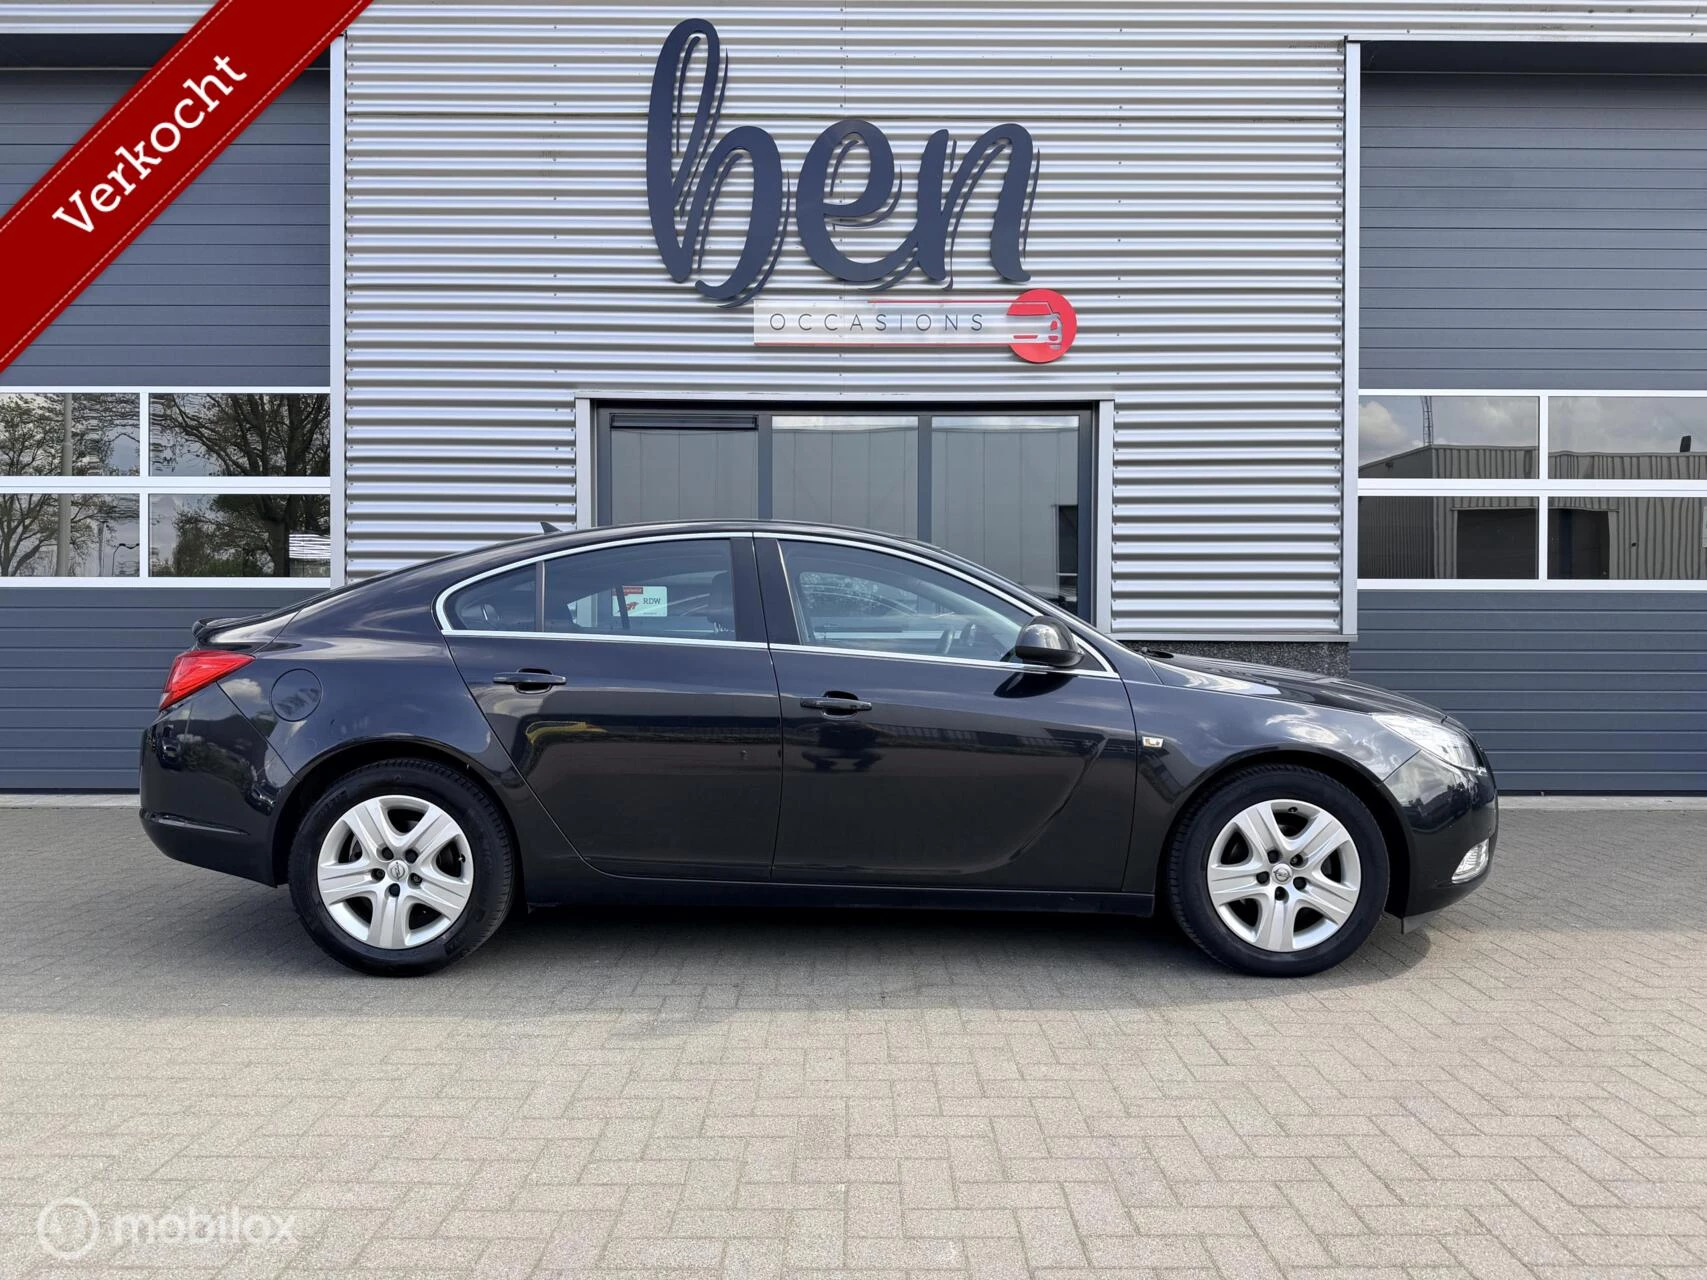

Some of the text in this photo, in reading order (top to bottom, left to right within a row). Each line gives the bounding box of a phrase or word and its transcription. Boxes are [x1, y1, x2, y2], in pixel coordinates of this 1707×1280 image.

[646, 17, 1038, 306] ben
[769, 312, 984, 332] OCCASIONS
[643, 597, 661, 605] RDW
